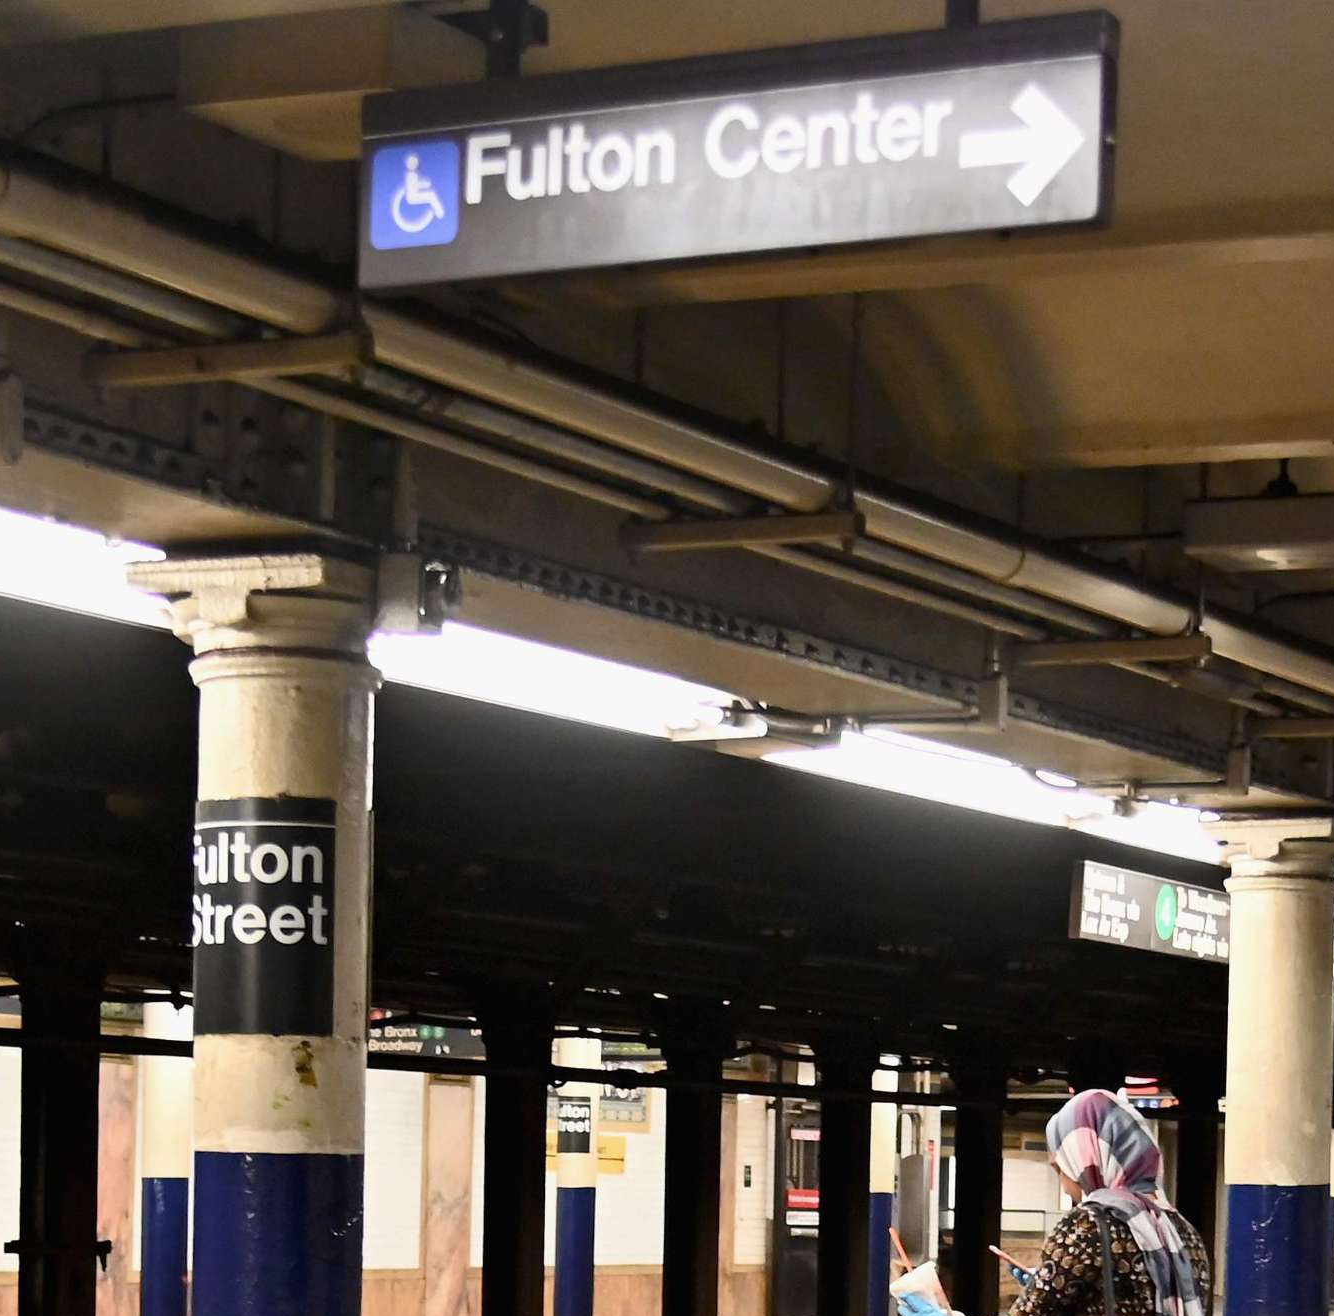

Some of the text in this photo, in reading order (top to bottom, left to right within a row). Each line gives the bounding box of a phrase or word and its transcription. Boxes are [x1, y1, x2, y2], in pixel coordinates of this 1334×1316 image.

[466, 93, 952, 204] Fulton Center
[384, 1025, 418, 1038] Bronx
[368, 1038, 424, 1054] Broadway
